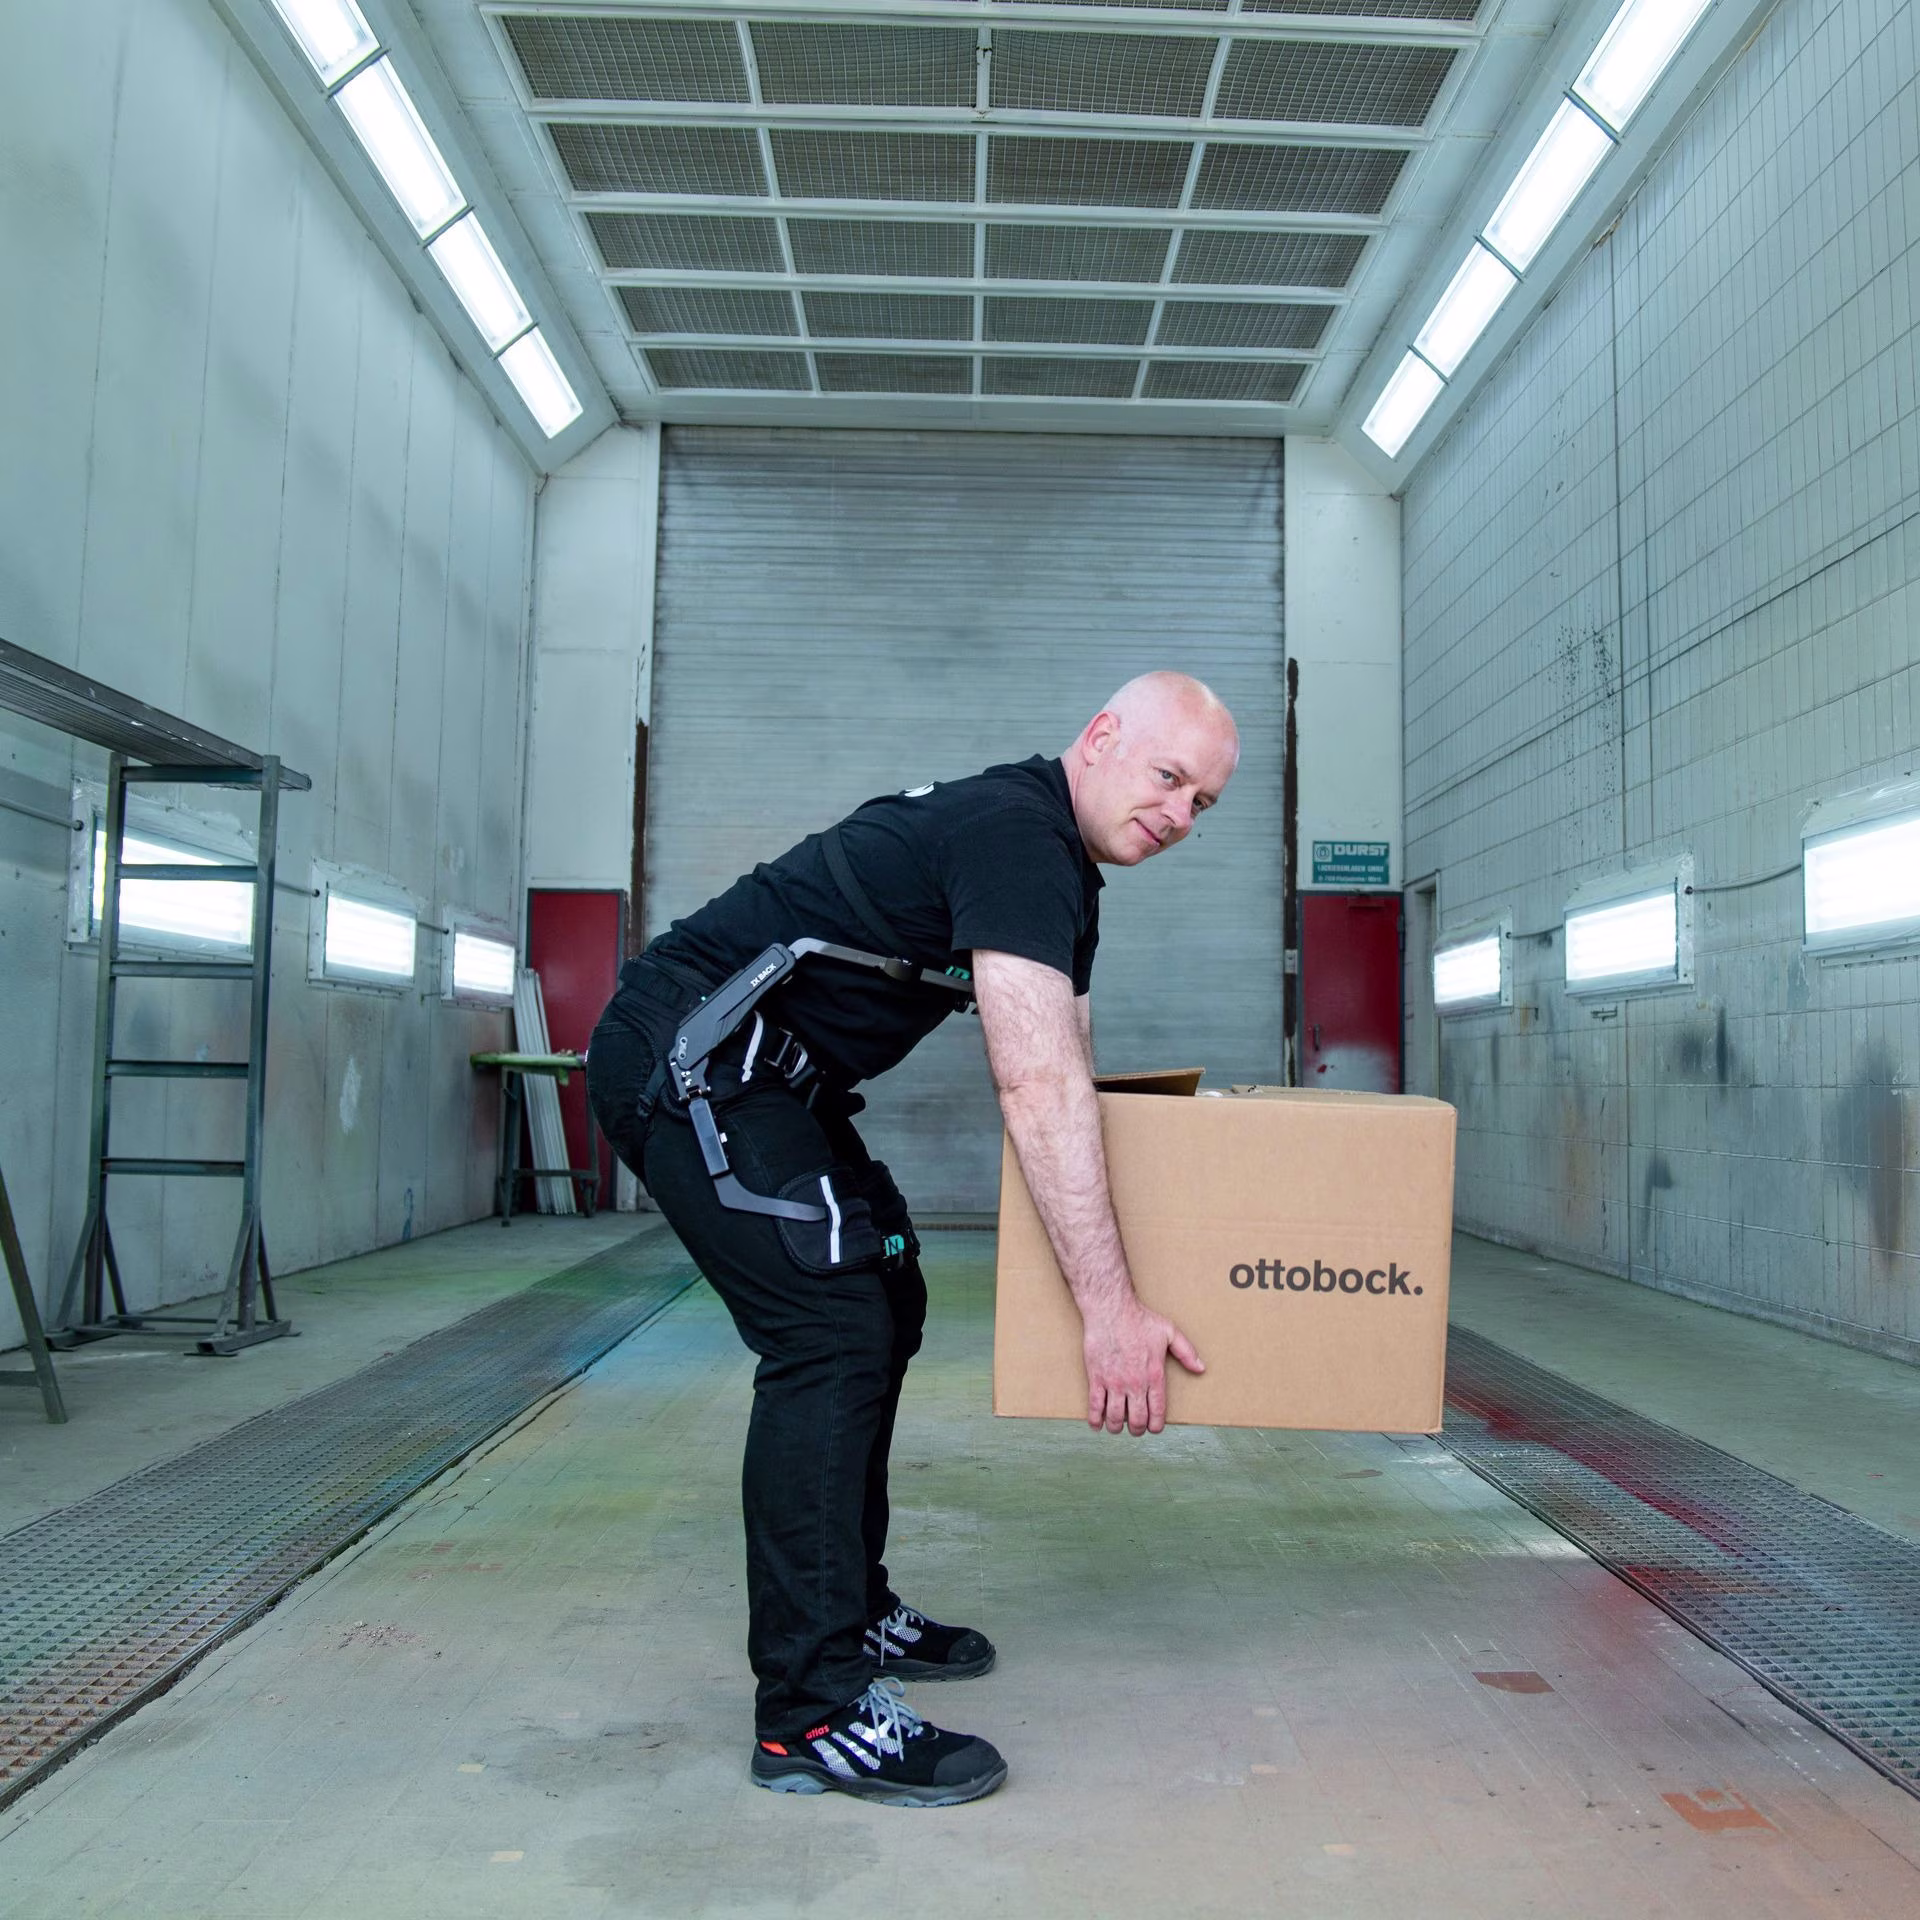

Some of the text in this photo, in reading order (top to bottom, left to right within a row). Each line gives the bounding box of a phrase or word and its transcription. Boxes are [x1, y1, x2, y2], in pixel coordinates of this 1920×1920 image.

[1334, 844, 1387, 856] DURST
[758, 963, 777, 980] BACK
[1229, 1258, 1423, 1296] ottobock.
[805, 1724, 830, 1740] atlas
